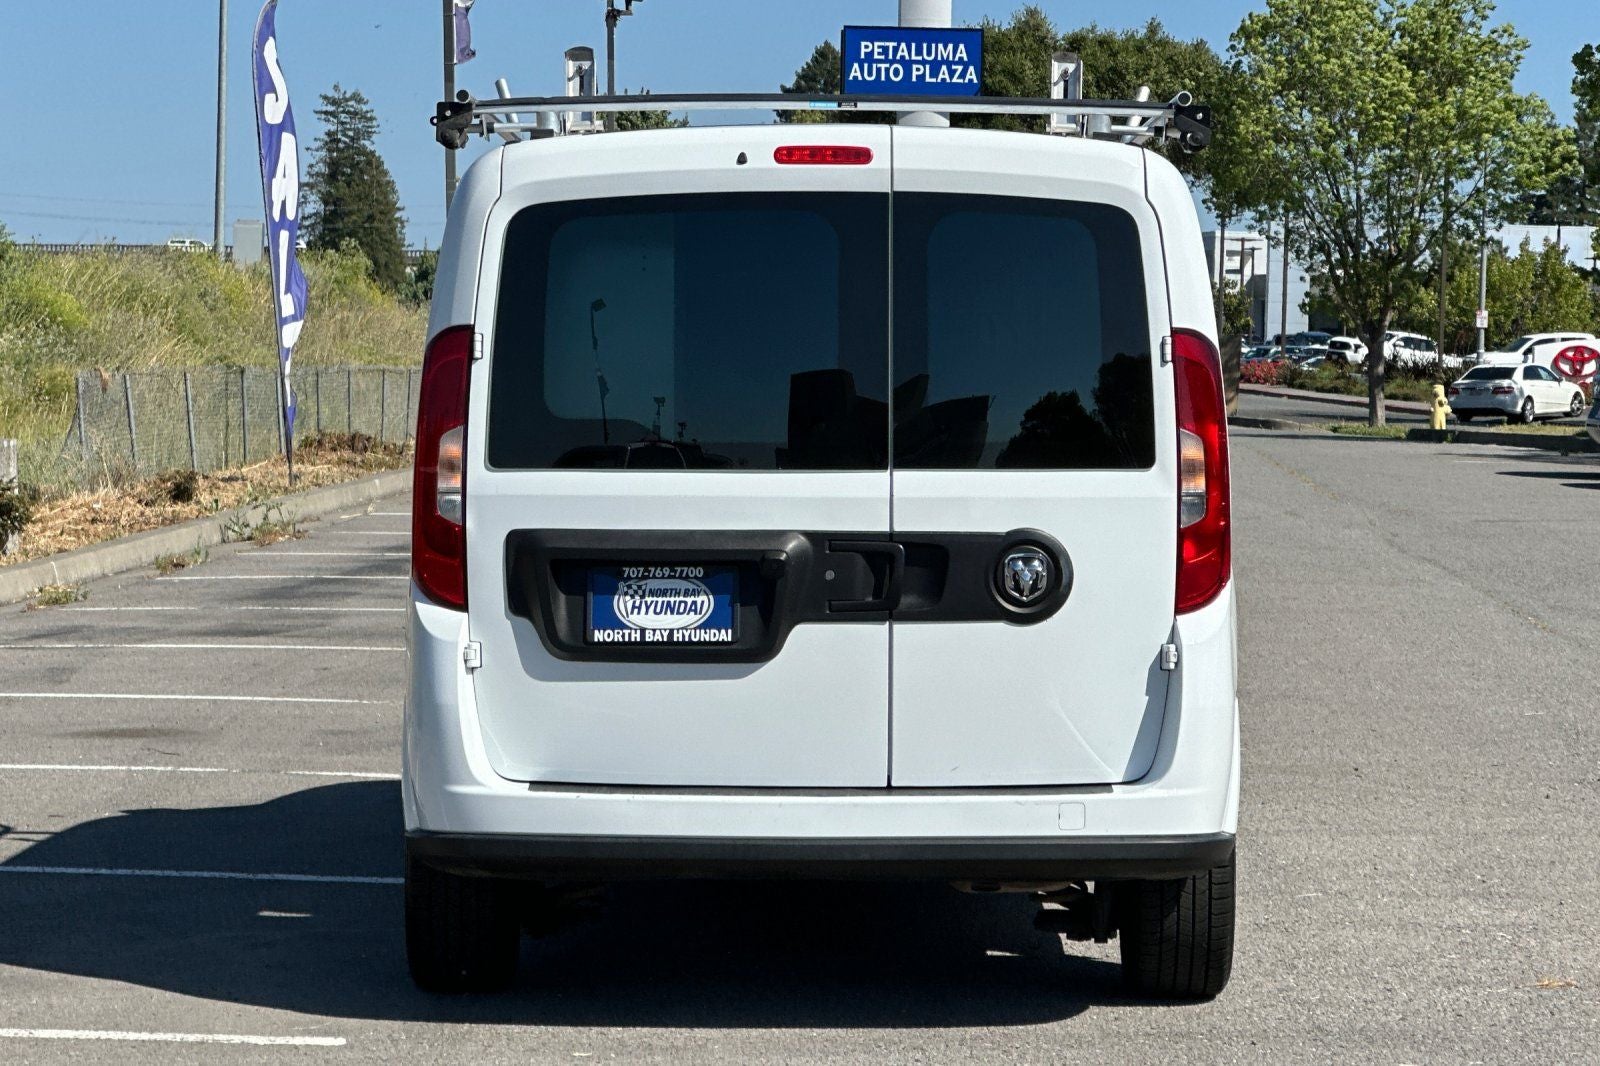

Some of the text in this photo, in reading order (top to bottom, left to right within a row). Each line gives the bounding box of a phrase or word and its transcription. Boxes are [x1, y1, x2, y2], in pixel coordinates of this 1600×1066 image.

[860, 41, 968, 61] PETALUMA
[849, 63, 978, 83] AUTO PLAZA
[622, 567, 704, 578] 707-769-7700
[647, 587, 704, 598] NORTH BAY
[630, 600, 706, 616] HYUNDAI
[594, 628, 732, 642] NORTH BAY HYUNDAI
